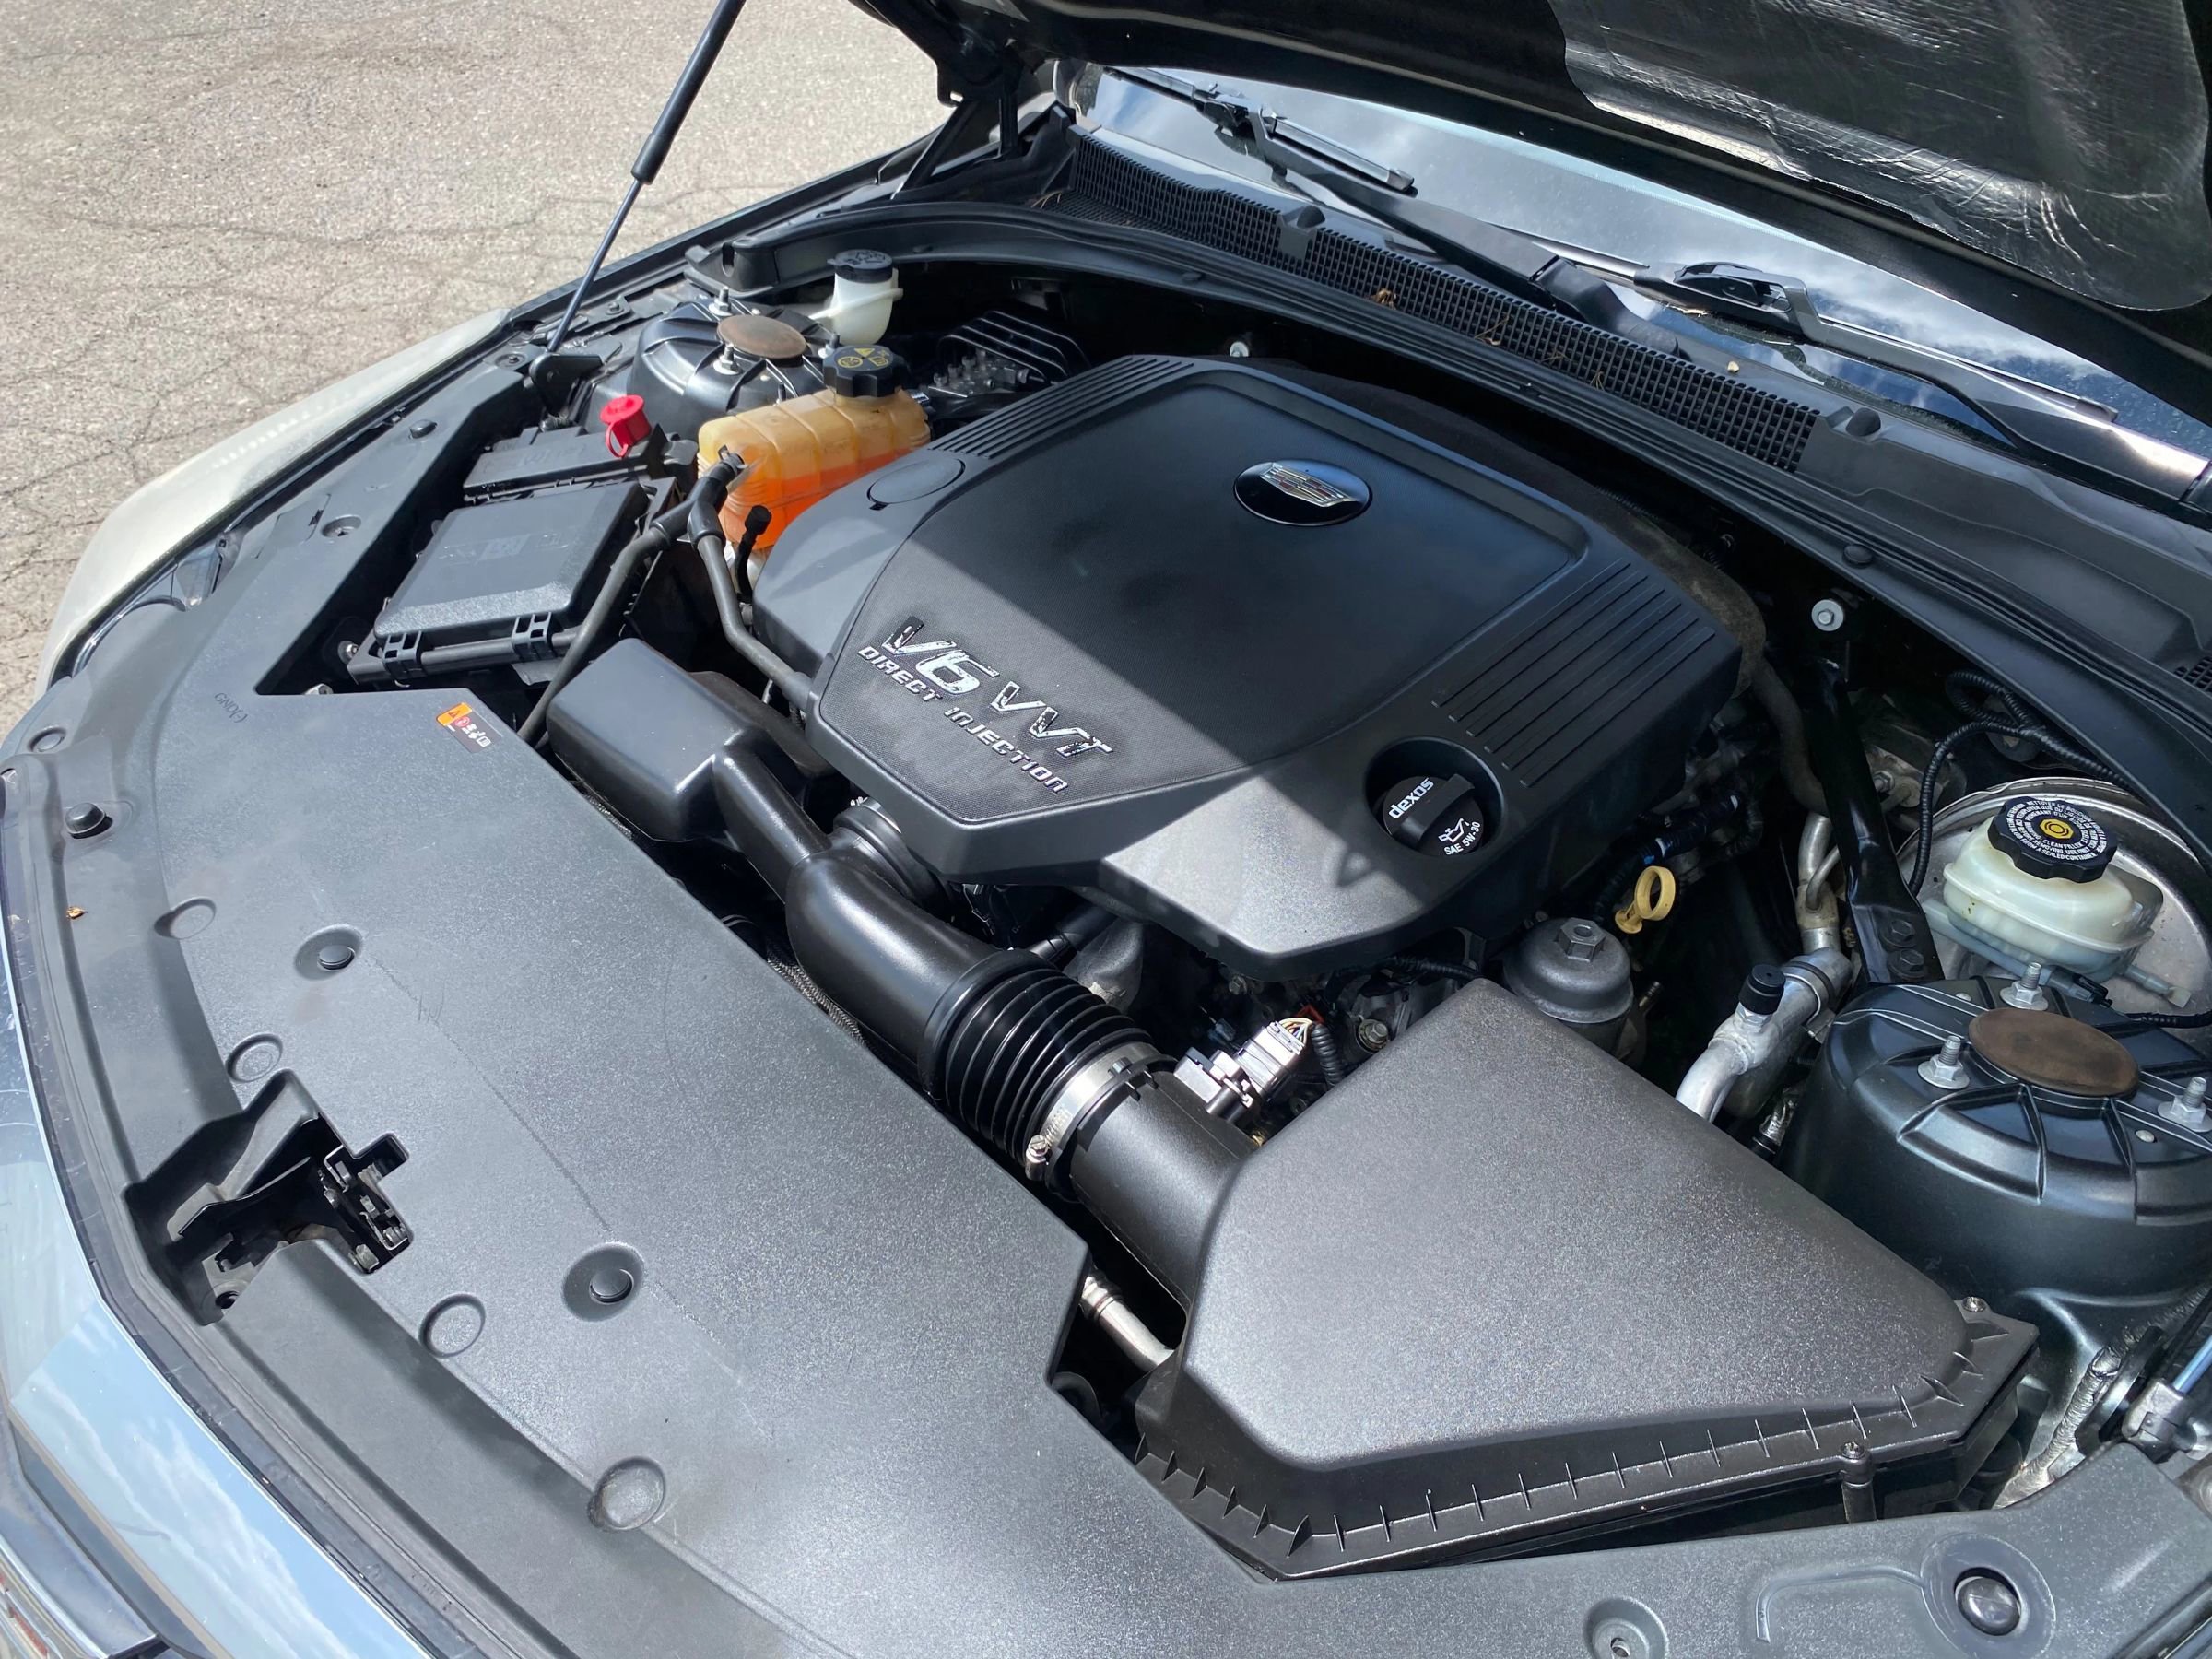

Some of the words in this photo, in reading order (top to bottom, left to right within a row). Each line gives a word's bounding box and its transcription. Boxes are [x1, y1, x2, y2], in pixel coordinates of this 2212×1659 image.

[881, 616, 1000, 694] V6
[991, 681, 1112, 757] VVT
[858, 646, 943, 701] DIRECT
[944, 707, 1067, 793] INJECTION
[1389, 778, 1434, 819] dexos
[1444, 843, 1463, 855] SAE
[1462, 822, 1480, 847] 5W-30
[2020, 839, 2037, 849] FROM
[2042, 850, 2065, 860] SEALED
